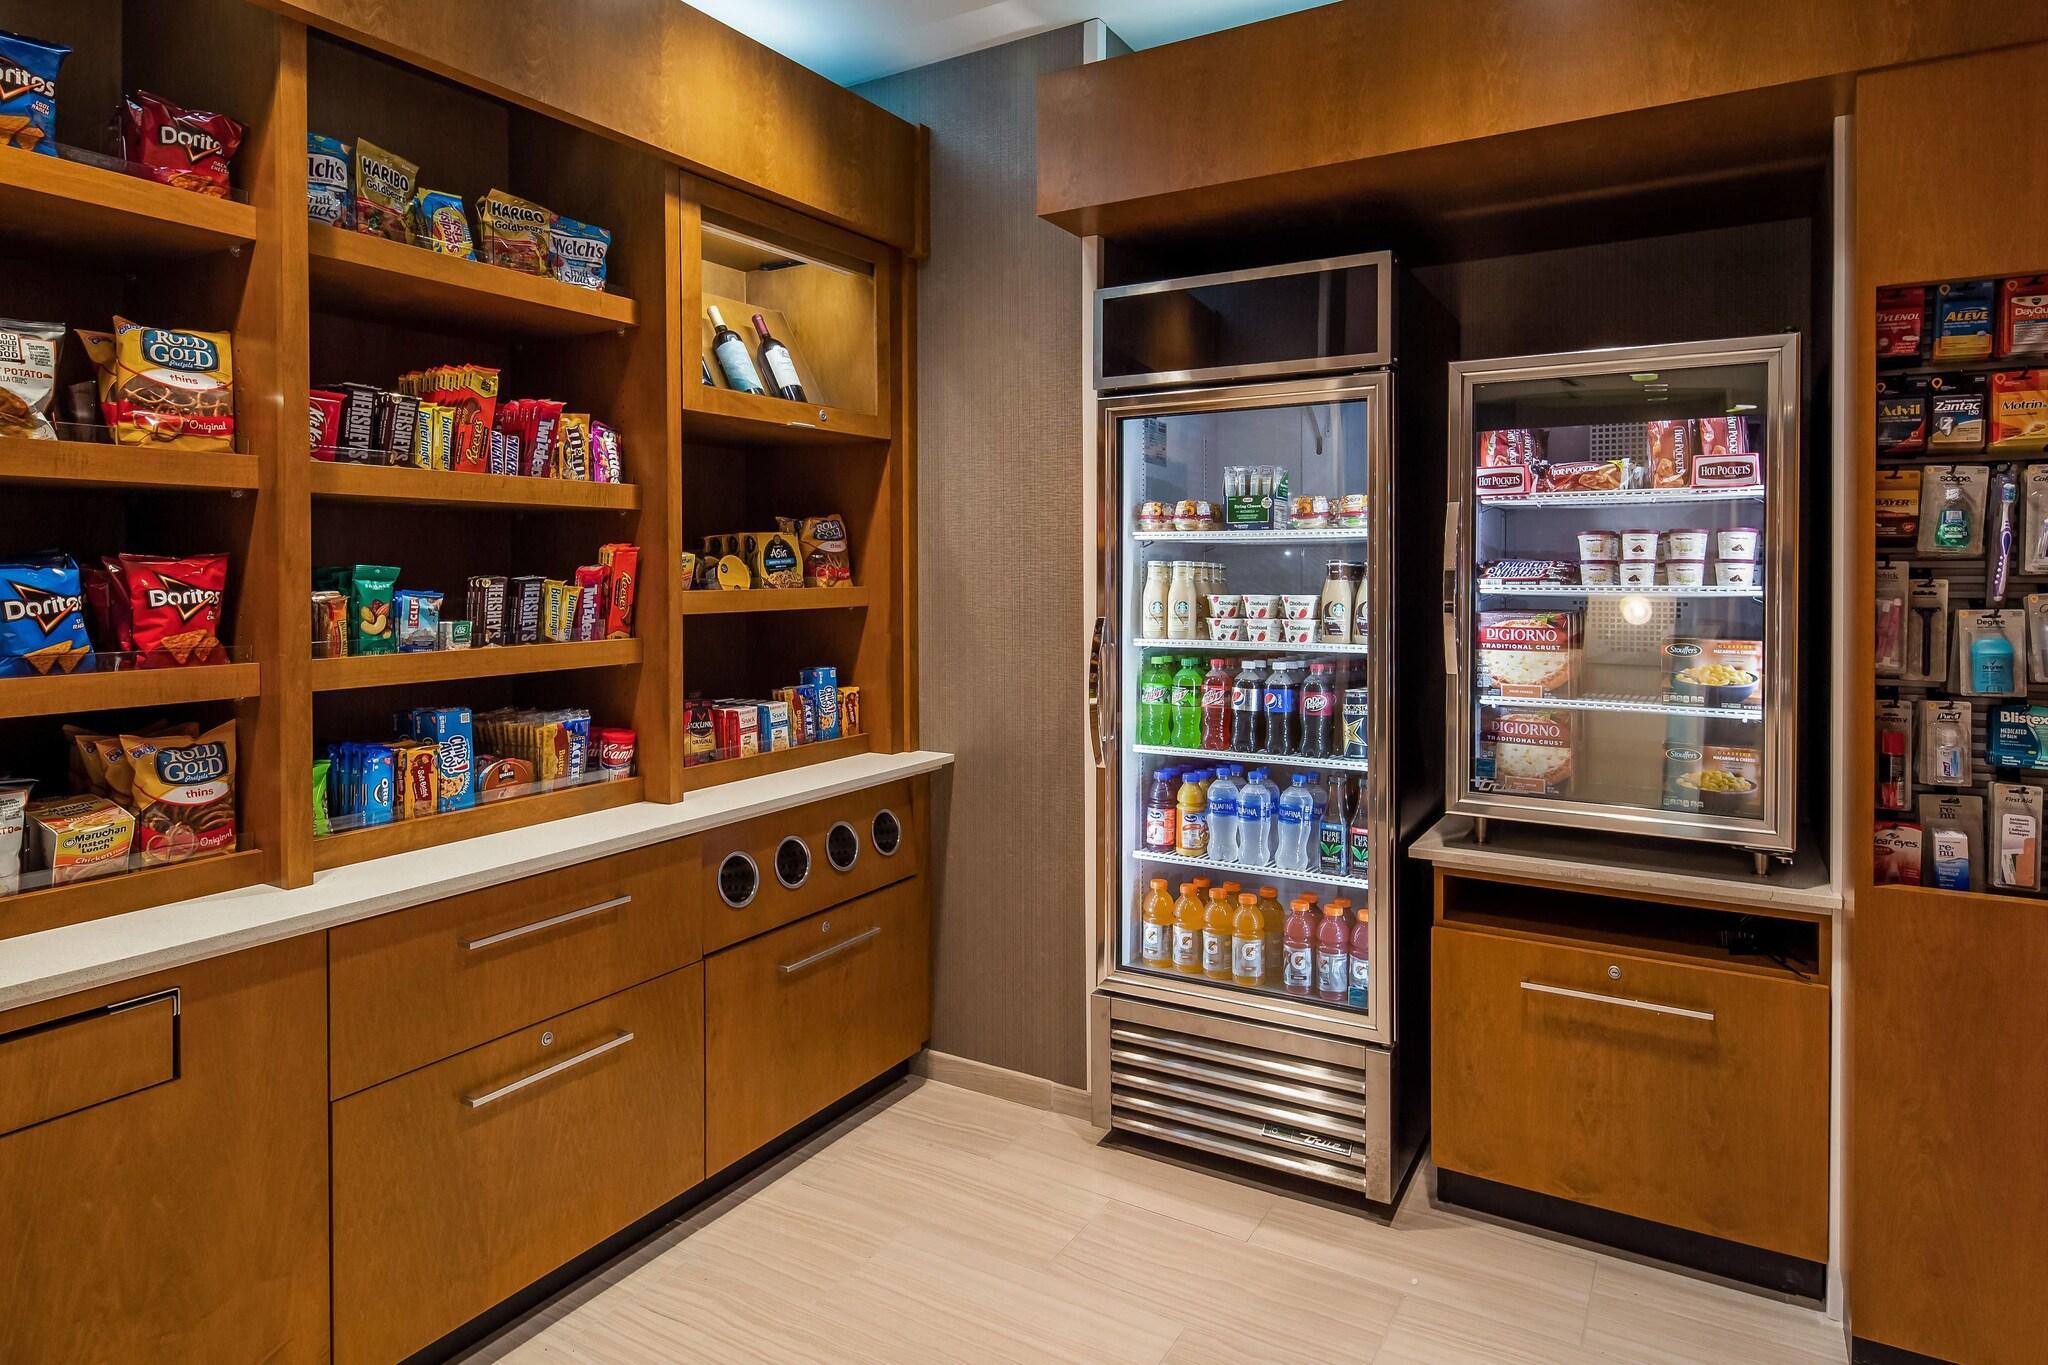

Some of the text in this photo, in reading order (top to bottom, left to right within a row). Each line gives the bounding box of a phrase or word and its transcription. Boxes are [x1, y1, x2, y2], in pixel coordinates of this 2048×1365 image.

[0, 66, 55, 97] ritos
[308, 157, 345, 182] lch's
[362, 156, 409, 192] HARIBO
[309, 194, 333, 206] ruit
[491, 201, 545, 224] HARIBO
[494, 220, 545, 235] Goldbears
[552, 236, 604, 259] Welch's
[1878, 313, 1921, 323] TYLENOL
[1944, 311, 1989, 322] ALEVE
[2015, 307, 2048, 318] DayQu
[154, 330, 211, 352] ROLD
[146, 344, 214, 368] GOLD
[4, 367, 43, 379] POTATO
[169, 374, 199, 385] thins
[1880, 404, 1921, 416] Advil
[1935, 401, 1981, 411] Zantac
[2002, 400, 2043, 410] Motrin
[189, 419, 228, 432] Original
[418, 410, 432, 466] Butterfinger
[491, 431, 504, 475] SNICKER
[505, 435, 519, 476] SNICKER
[1701, 464, 1751, 476] HOT POCKETS
[1478, 475, 1521, 486] HOT POCKETS
[149, 589, 222, 609] Doritos
[4, 594, 82, 621] Doritos
[1977, 618, 2006, 626] Degree
[1486, 628, 1557, 642] DIGIORNO
[2000, 711, 2048, 728] Blistex
[1491, 720, 1560, 737] DIGIORNO
[1487, 735, 1537, 745] TRADITIONAL
[170, 743, 219, 762] ROLD
[448, 735, 467, 767] Chips
[164, 757, 223, 782] GOLD
[558, 749, 566, 775] Butter
[186, 787, 215, 799] thins
[74, 825, 127, 843] Maruchan
[200, 828, 233, 847] Original
[78, 836, 114, 849] Instant
[81, 843, 110, 855] Lunch
[1873, 838, 1920, 849] lear eyes
[75, 851, 112, 864] Chicken
